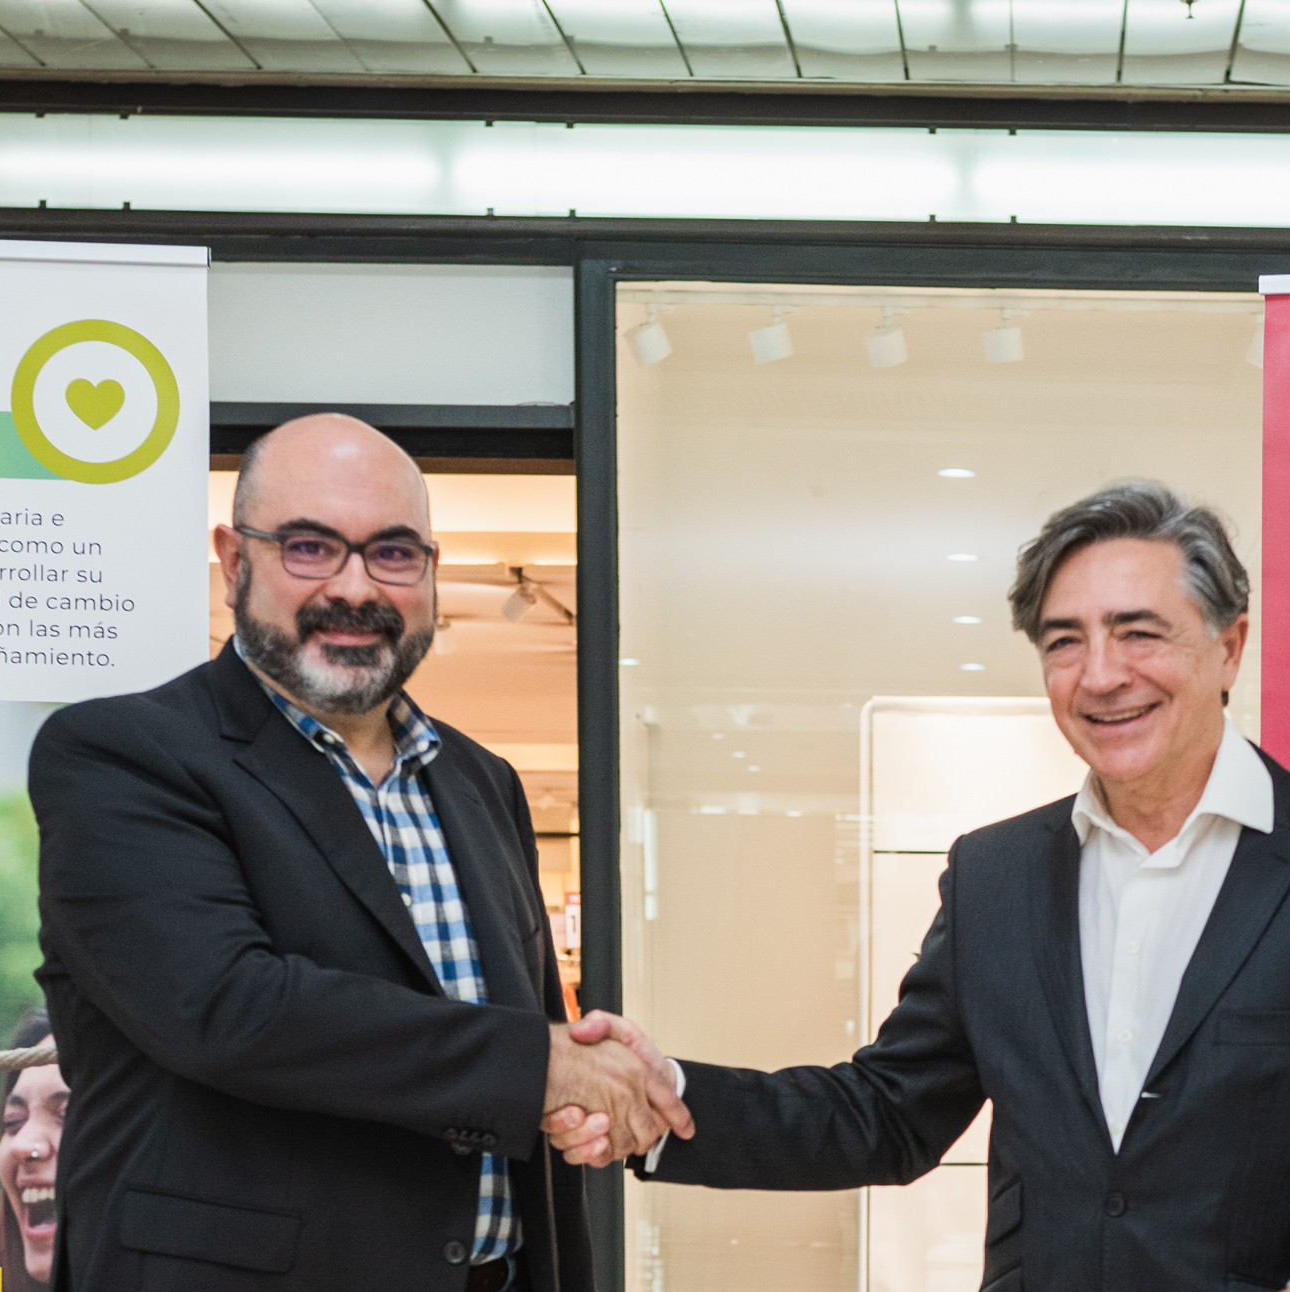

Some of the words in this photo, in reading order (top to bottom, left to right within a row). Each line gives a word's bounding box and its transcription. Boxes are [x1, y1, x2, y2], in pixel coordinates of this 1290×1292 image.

[51, 513, 65, 527] e
[72, 541, 102, 556] un
[76, 569, 103, 584] su
[8, 591, 39, 610] de
[45, 593, 136, 613] cambio
[29, 619, 61, 638] las
[68, 621, 119, 640] más
